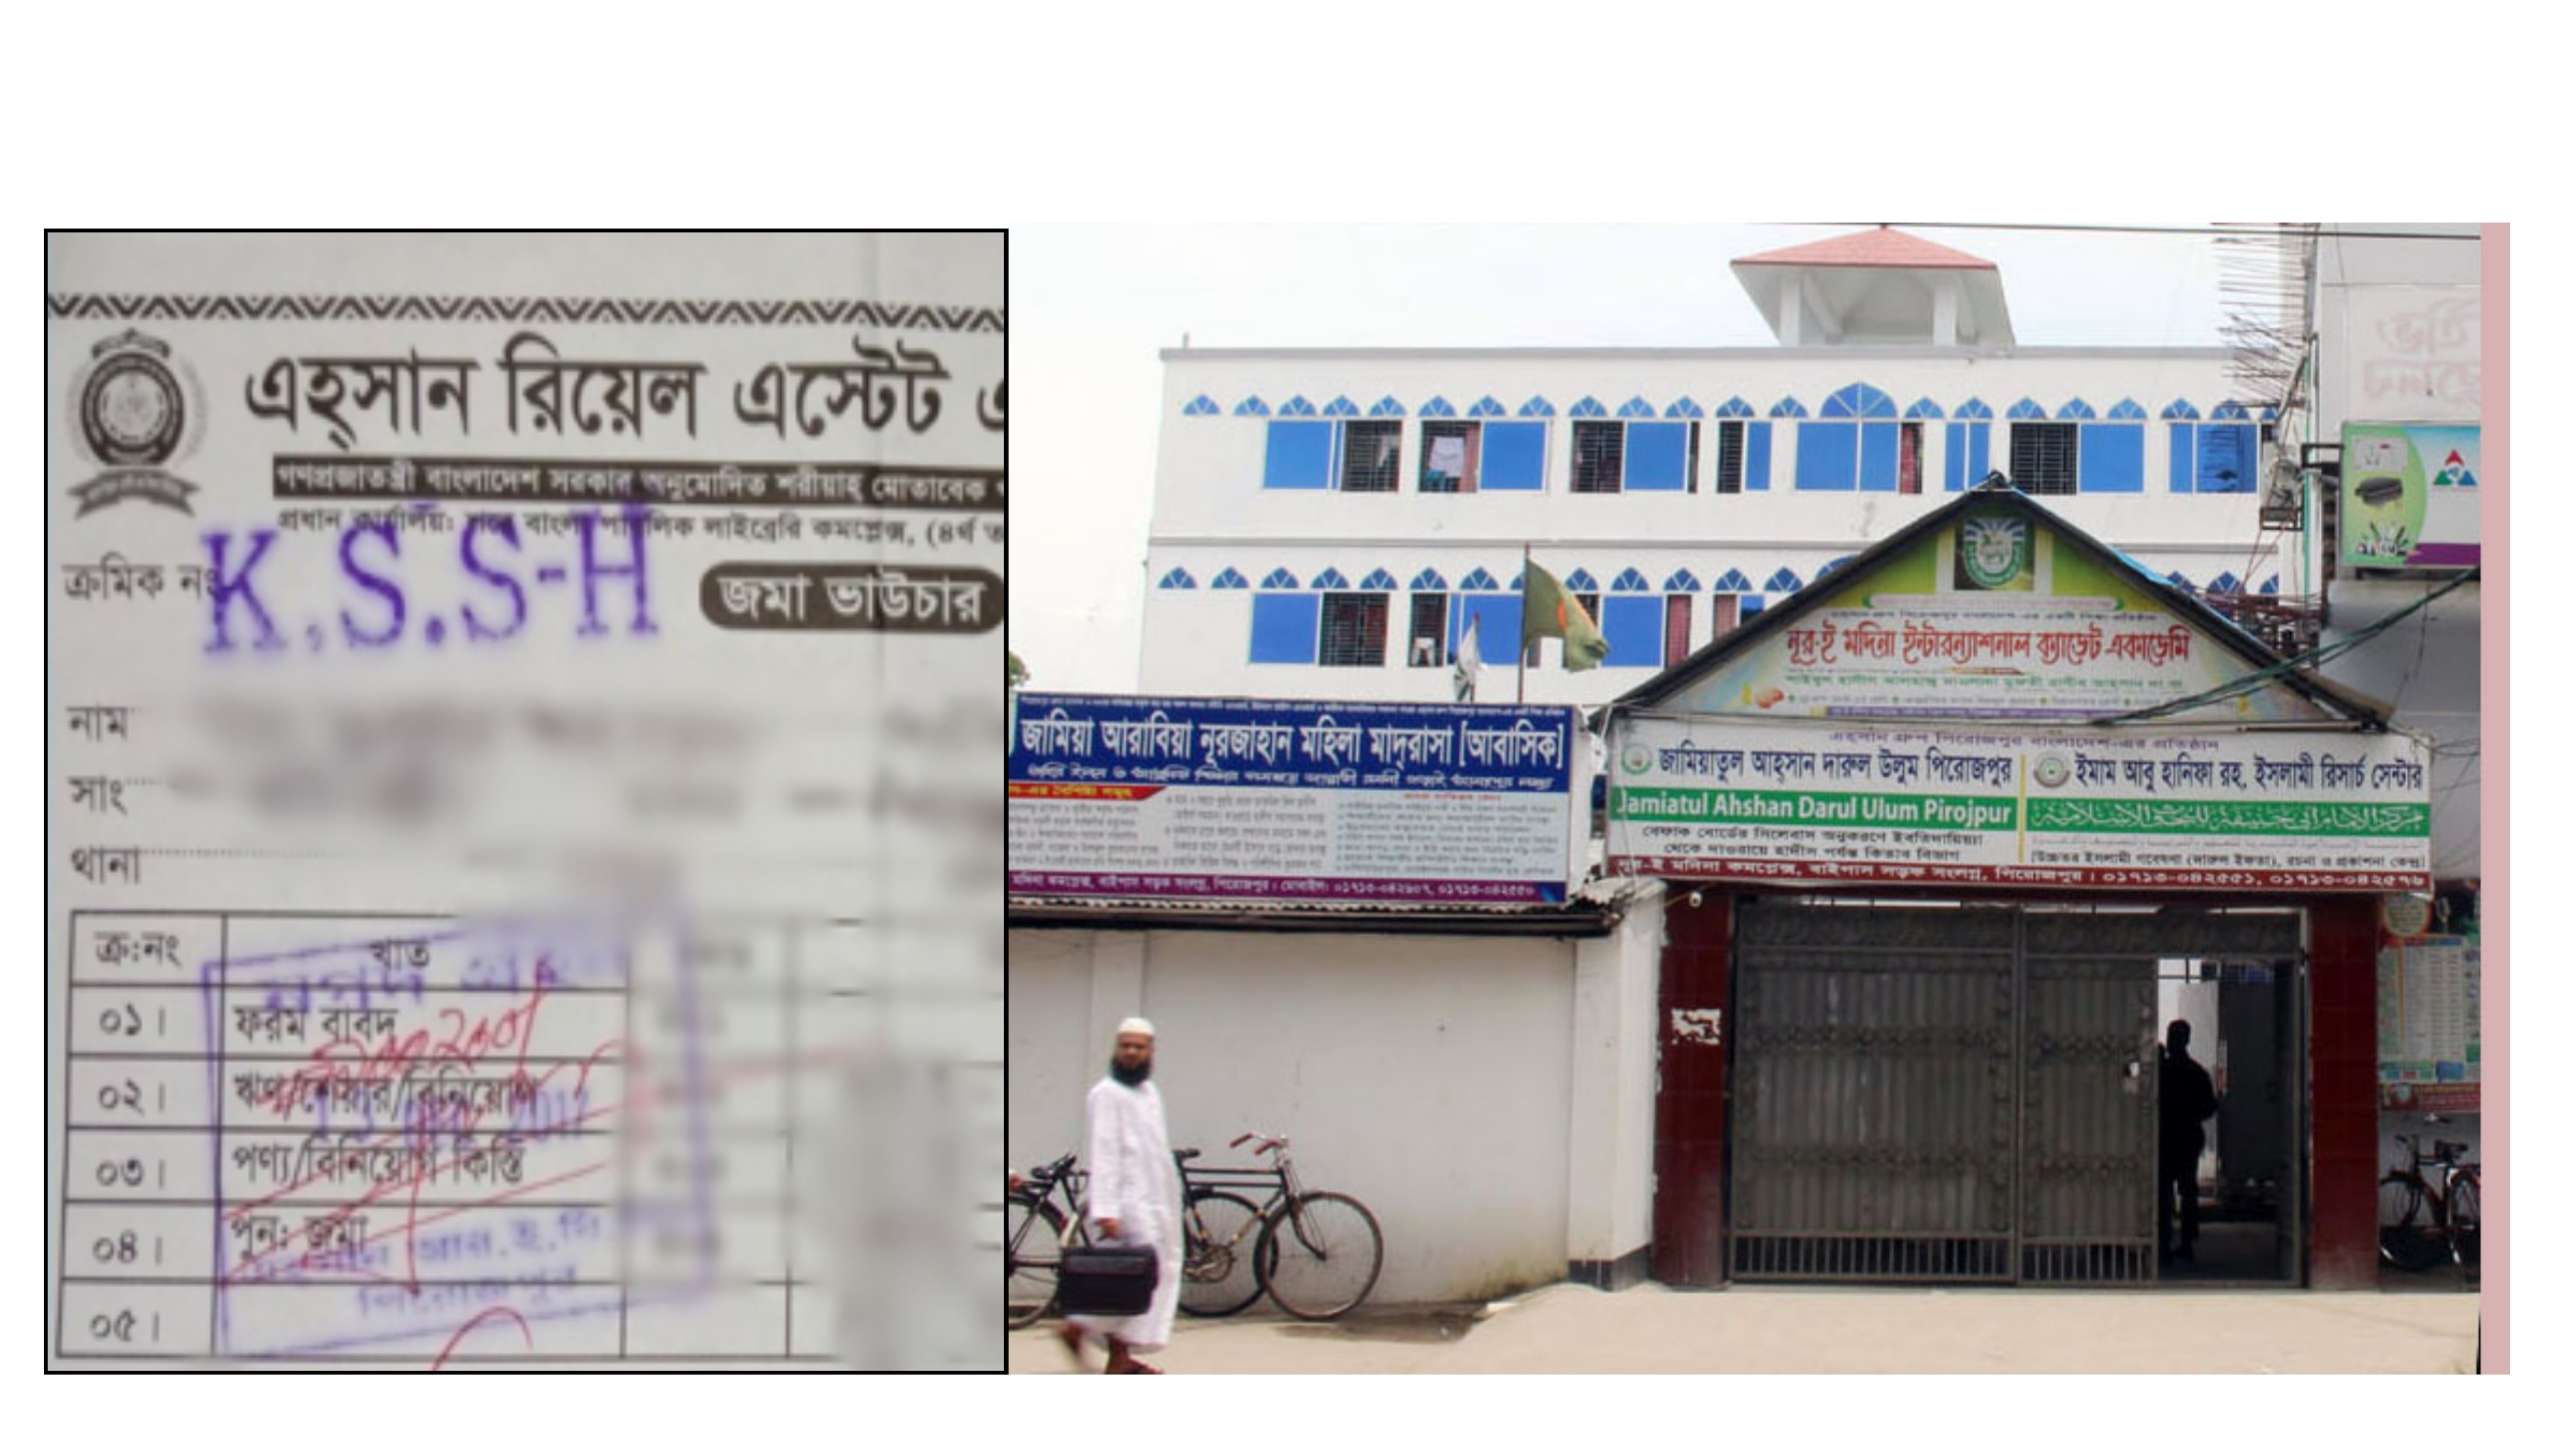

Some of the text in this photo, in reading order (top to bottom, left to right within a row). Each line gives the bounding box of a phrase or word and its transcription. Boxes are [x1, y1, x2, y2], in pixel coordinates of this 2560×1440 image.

[496, 331, 708, 438] রিয়েল
[734, 334, 952, 439] এস্টেট
[424, 464, 541, 495] বাংলাদেশ
[548, 465, 632, 495] সরকার
[872, 473, 987, 502] মোতাবেক
[277, 508, 342, 532] প্রধান
[524, 511, 589, 538] বাংল
[600, 510, 694, 538] পালিক
[62, 550, 165, 601] ক্রমিক
[716, 565, 989, 625] জমা ভাউচার
[1902, 618, 2033, 665] ইন্টারন্যাশনাল
[2037, 620, 2104, 666] ক্যাডেট
[2107, 623, 2193, 667] একাডেমি
[66, 706, 129, 742] নাম
[1019, 707, 1096, 757] জামিয়া
[1100, 709, 1195, 759] আরাবিয়া
[1299, 714, 1364, 767] মহিলা
[1658, 738, 1745, 784] জামিয়াতুল
[1822, 751, 1872, 779] দারুল
[1925, 745, 2013, 789] পিরোজপুর
[2074, 751, 2117, 786] ইমাম
[2122, 757, 2156, 793] আবু
[2160, 750, 2215, 790] হানিফা
[2253, 751, 2315, 791] ইসলামী
[2320, 752, 2368, 790] রিসার্চ
[2371, 757, 2424, 791] সেন্টার
[68, 775, 128, 815] সাং
[1615, 787, 2012, 828] Jamiatul Ahshan Darul Ulum Pirojpur
[70, 847, 143, 885] থানা
[369, 937, 432, 971] খাত
[233, 1005, 308, 1041] ফরম
[320, 1006, 400, 1044] বাবদ
[301, 1216, 370, 1251] জমা
